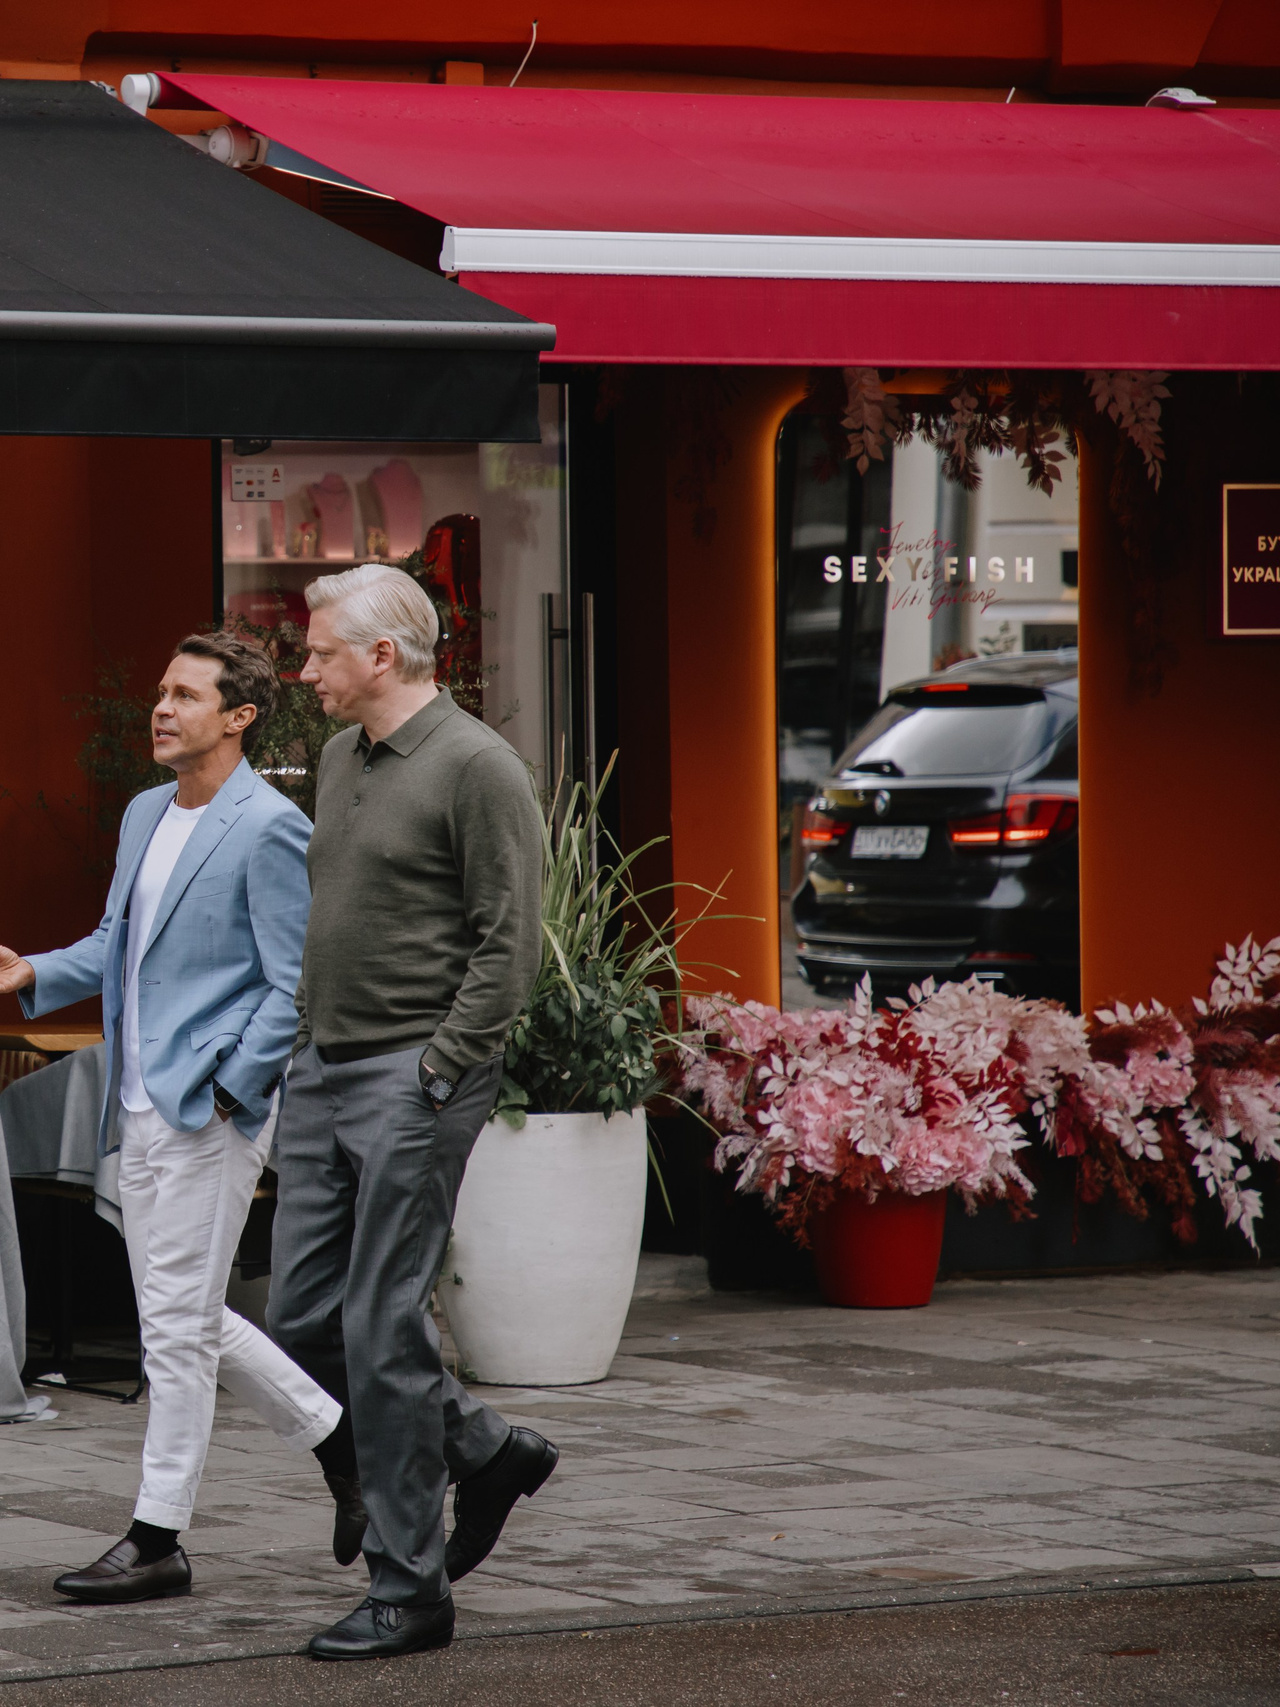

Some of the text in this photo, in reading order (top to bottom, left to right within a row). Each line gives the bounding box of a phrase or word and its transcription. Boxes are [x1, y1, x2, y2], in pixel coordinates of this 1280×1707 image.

[1257, 535, 1280, 552] БУ
[823, 555, 1034, 583] SEXY FISH
